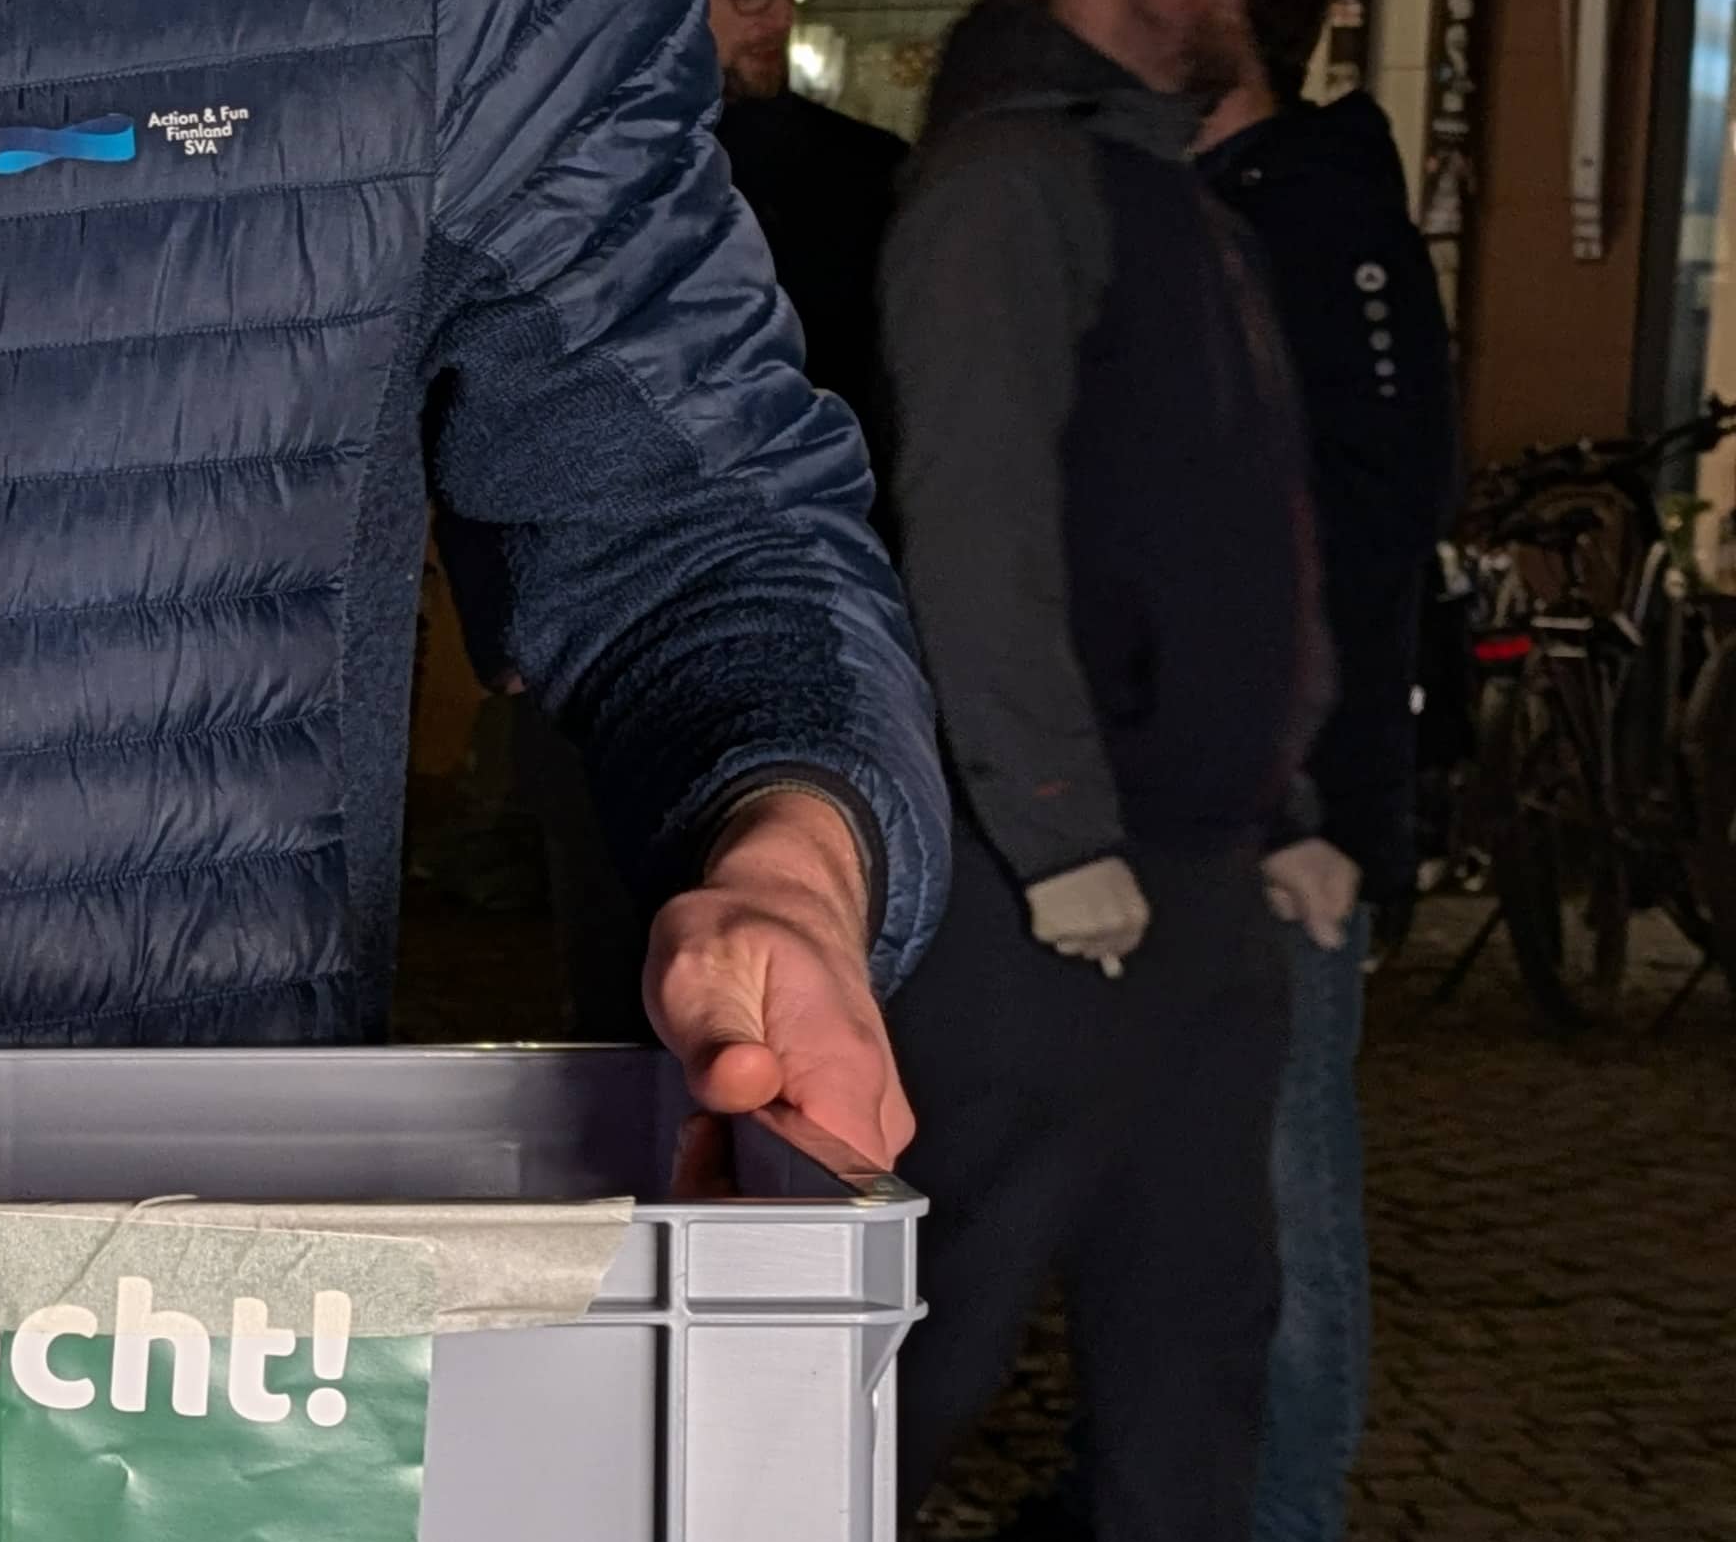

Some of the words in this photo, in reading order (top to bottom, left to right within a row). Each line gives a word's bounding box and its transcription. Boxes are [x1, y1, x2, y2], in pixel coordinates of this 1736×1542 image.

[147, 110, 199, 129] Action
[203, 107, 217, 123] &
[220, 105, 249, 121] Fun
[166, 120, 233, 142] Finnland
[184, 139, 218, 155] SVA
